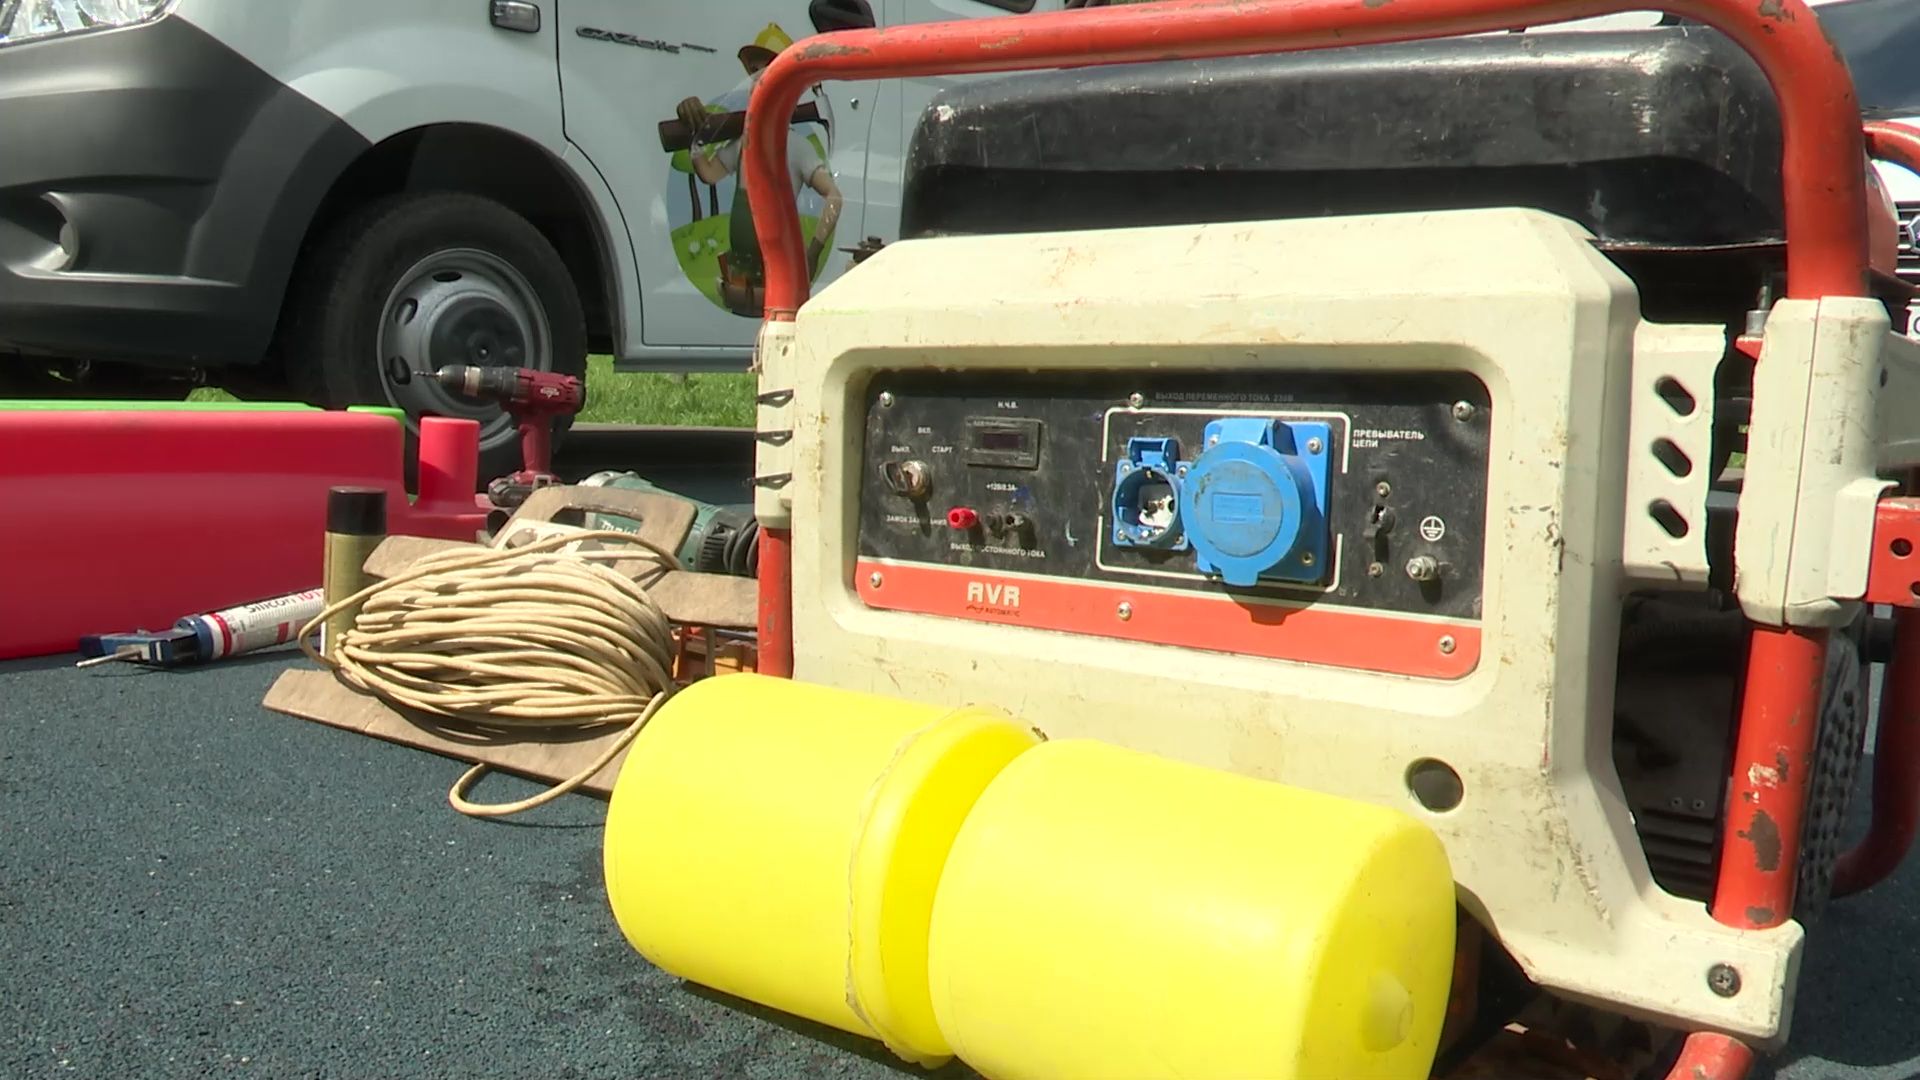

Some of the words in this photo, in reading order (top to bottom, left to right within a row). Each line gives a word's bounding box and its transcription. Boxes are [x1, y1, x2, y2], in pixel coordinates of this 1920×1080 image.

[1155, 392, 1185, 401] ВЫХОД
[1185, 392, 1246, 402] ПЕРЕМЕННОГО
[1248, 394, 1271, 402] ТОКА
[1353, 439, 1378, 448] ЦЕПИ
[931, 445, 953, 453] СТАРТ
[967, 581, 1020, 608] AVR
[243, 598, 297, 613] Silicon
